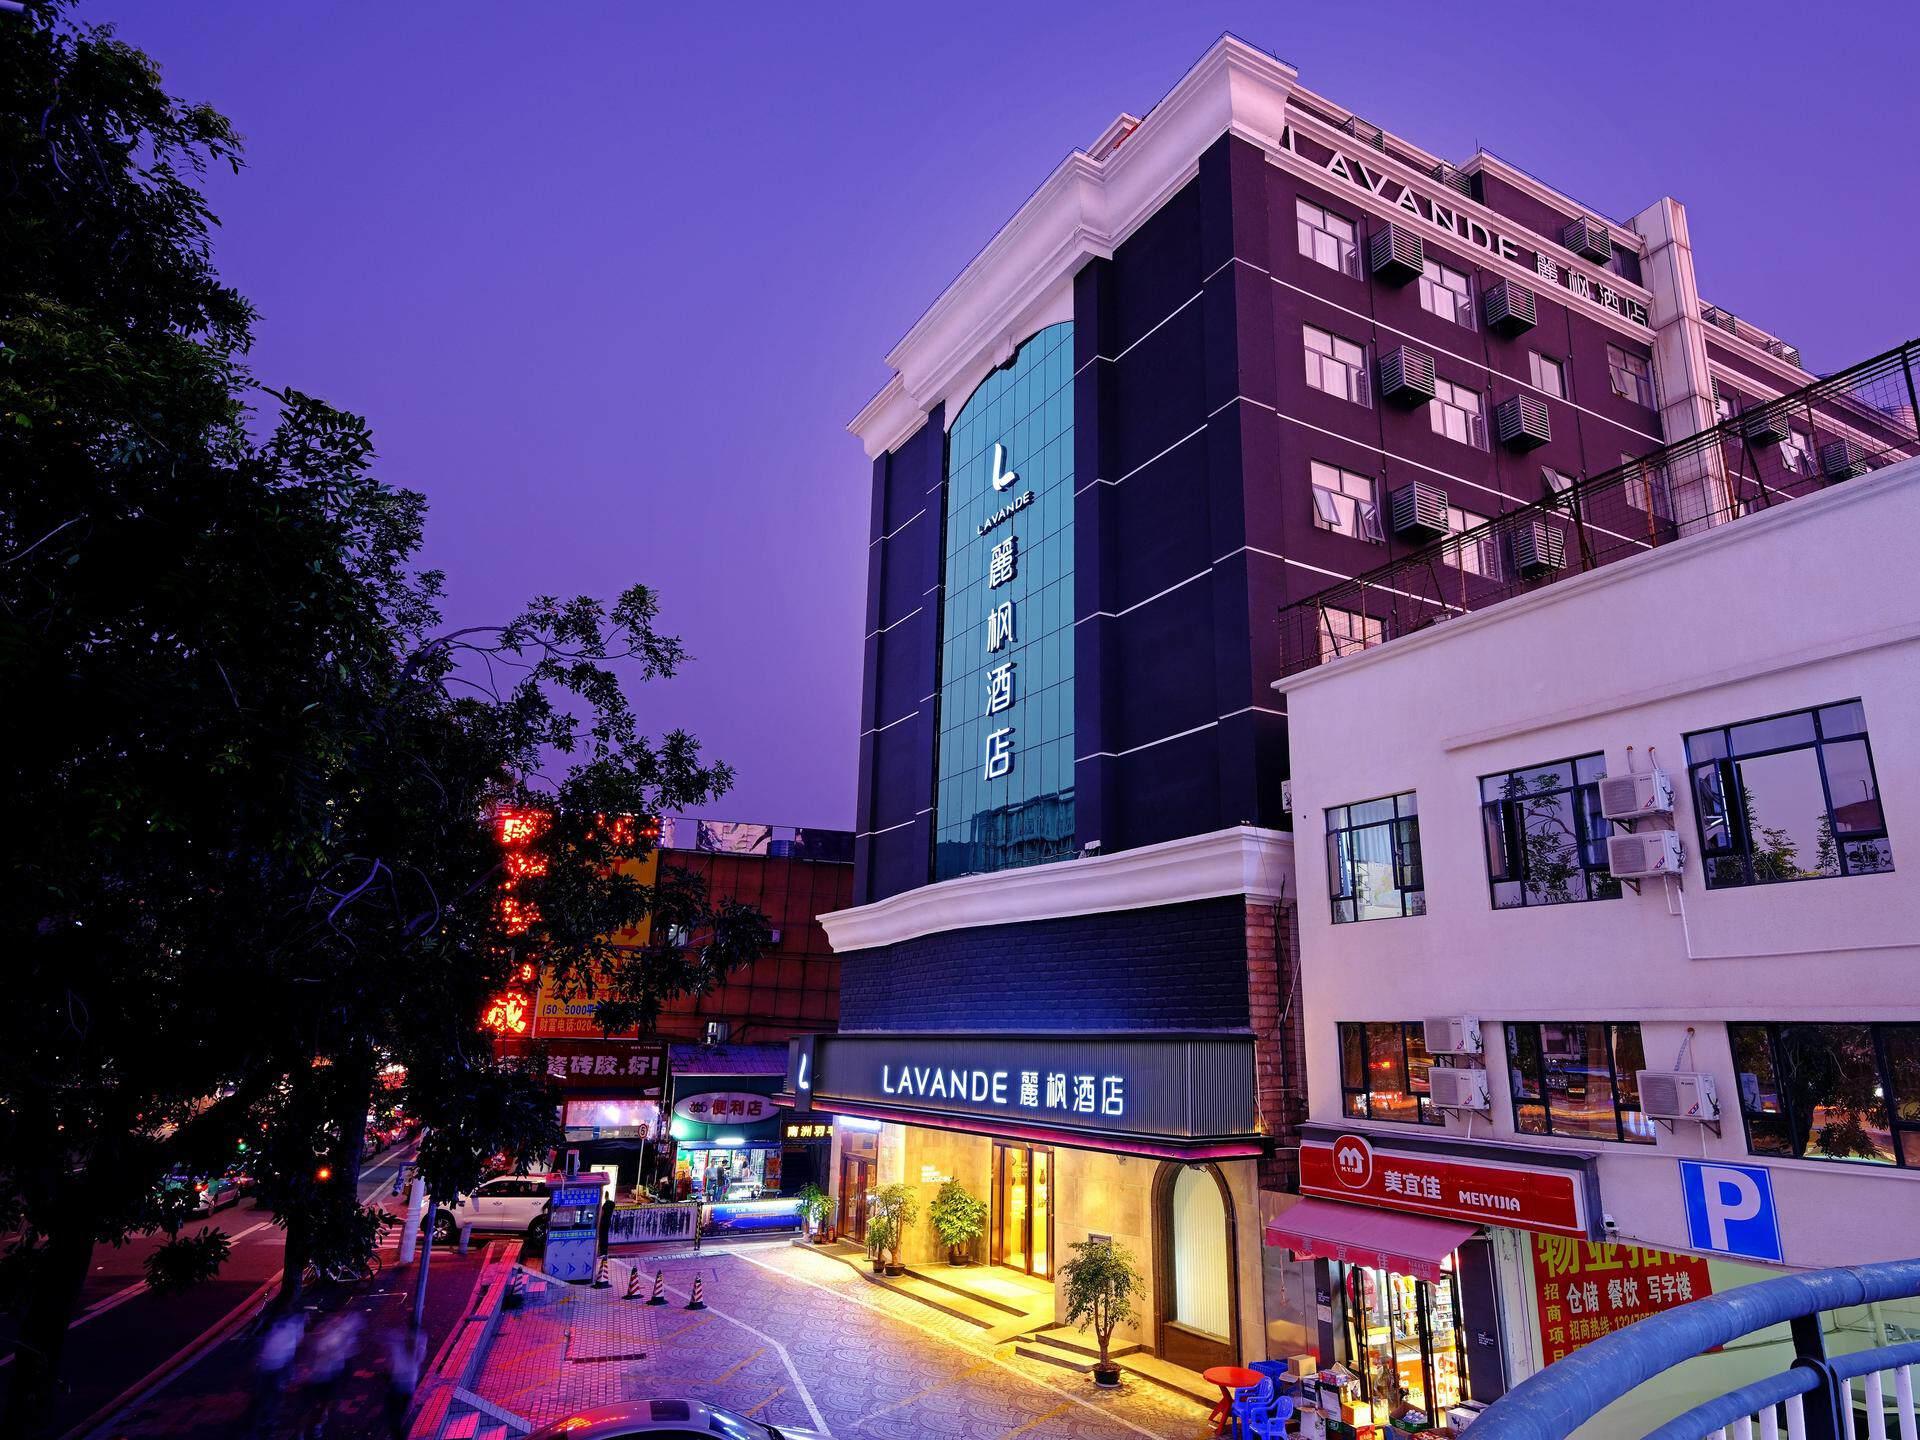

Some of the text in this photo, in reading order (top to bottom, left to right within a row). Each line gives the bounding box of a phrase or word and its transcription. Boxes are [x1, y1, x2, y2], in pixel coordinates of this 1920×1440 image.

[976, 491, 1032, 536] LAVANDE
[882, 1064, 1009, 1104] LAVANDE
[1384, 1169, 1442, 1200] 美宜佳
[1701, 1165, 1761, 1252] P
[1566, 1271, 1693, 1314] 仓储 餐饮 写字楼
